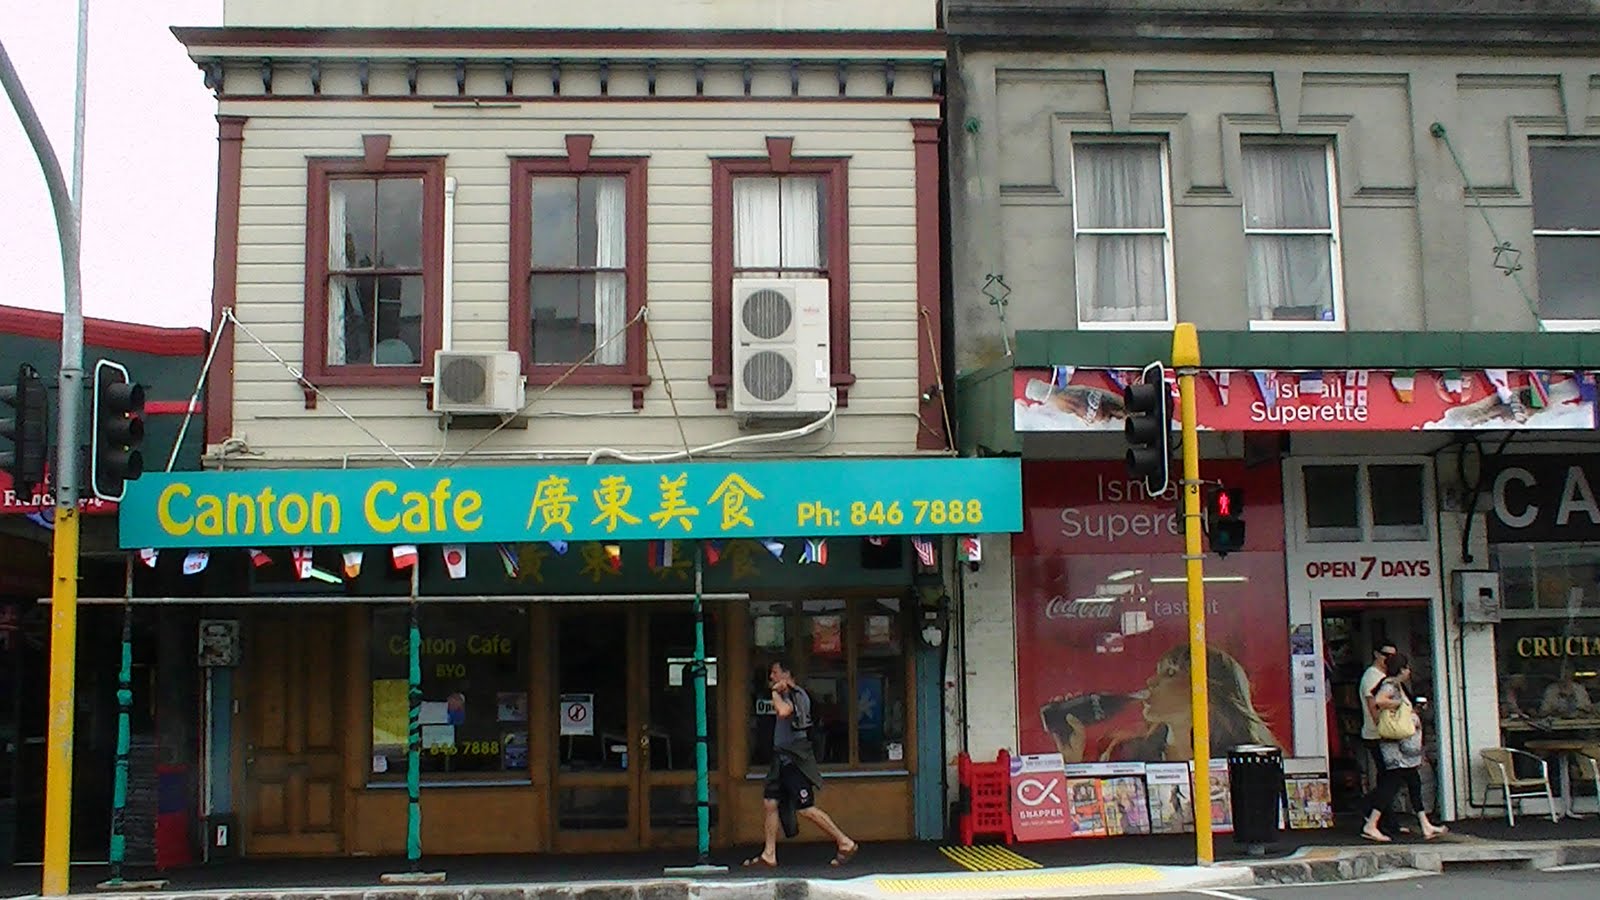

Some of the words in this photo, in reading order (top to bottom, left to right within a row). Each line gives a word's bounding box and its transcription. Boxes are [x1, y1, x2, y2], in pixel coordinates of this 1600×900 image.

[1275, 379, 1342, 399] Isail
[1251, 401, 1368, 425] Superette
[1190, 484, 1198, 494] 3
[157, 483, 341, 536] Canton
[364, 478, 484, 534] Cafe
[526, 472, 764, 533] 廣東美食
[797, 502, 841, 527] Ph:
[850, 501, 904, 526] 846
[912, 499, 983, 525] 7888
[1306, 561, 1356, 578] OPEN
[1360, 556, 1377, 581] 7
[1381, 560, 1431, 577] DAYS
[1154, 600, 1190, 616] tast
[467, 634, 512, 655] Cafe
[436, 663, 466, 678] BYO
[462, 741, 499, 755] 7888
